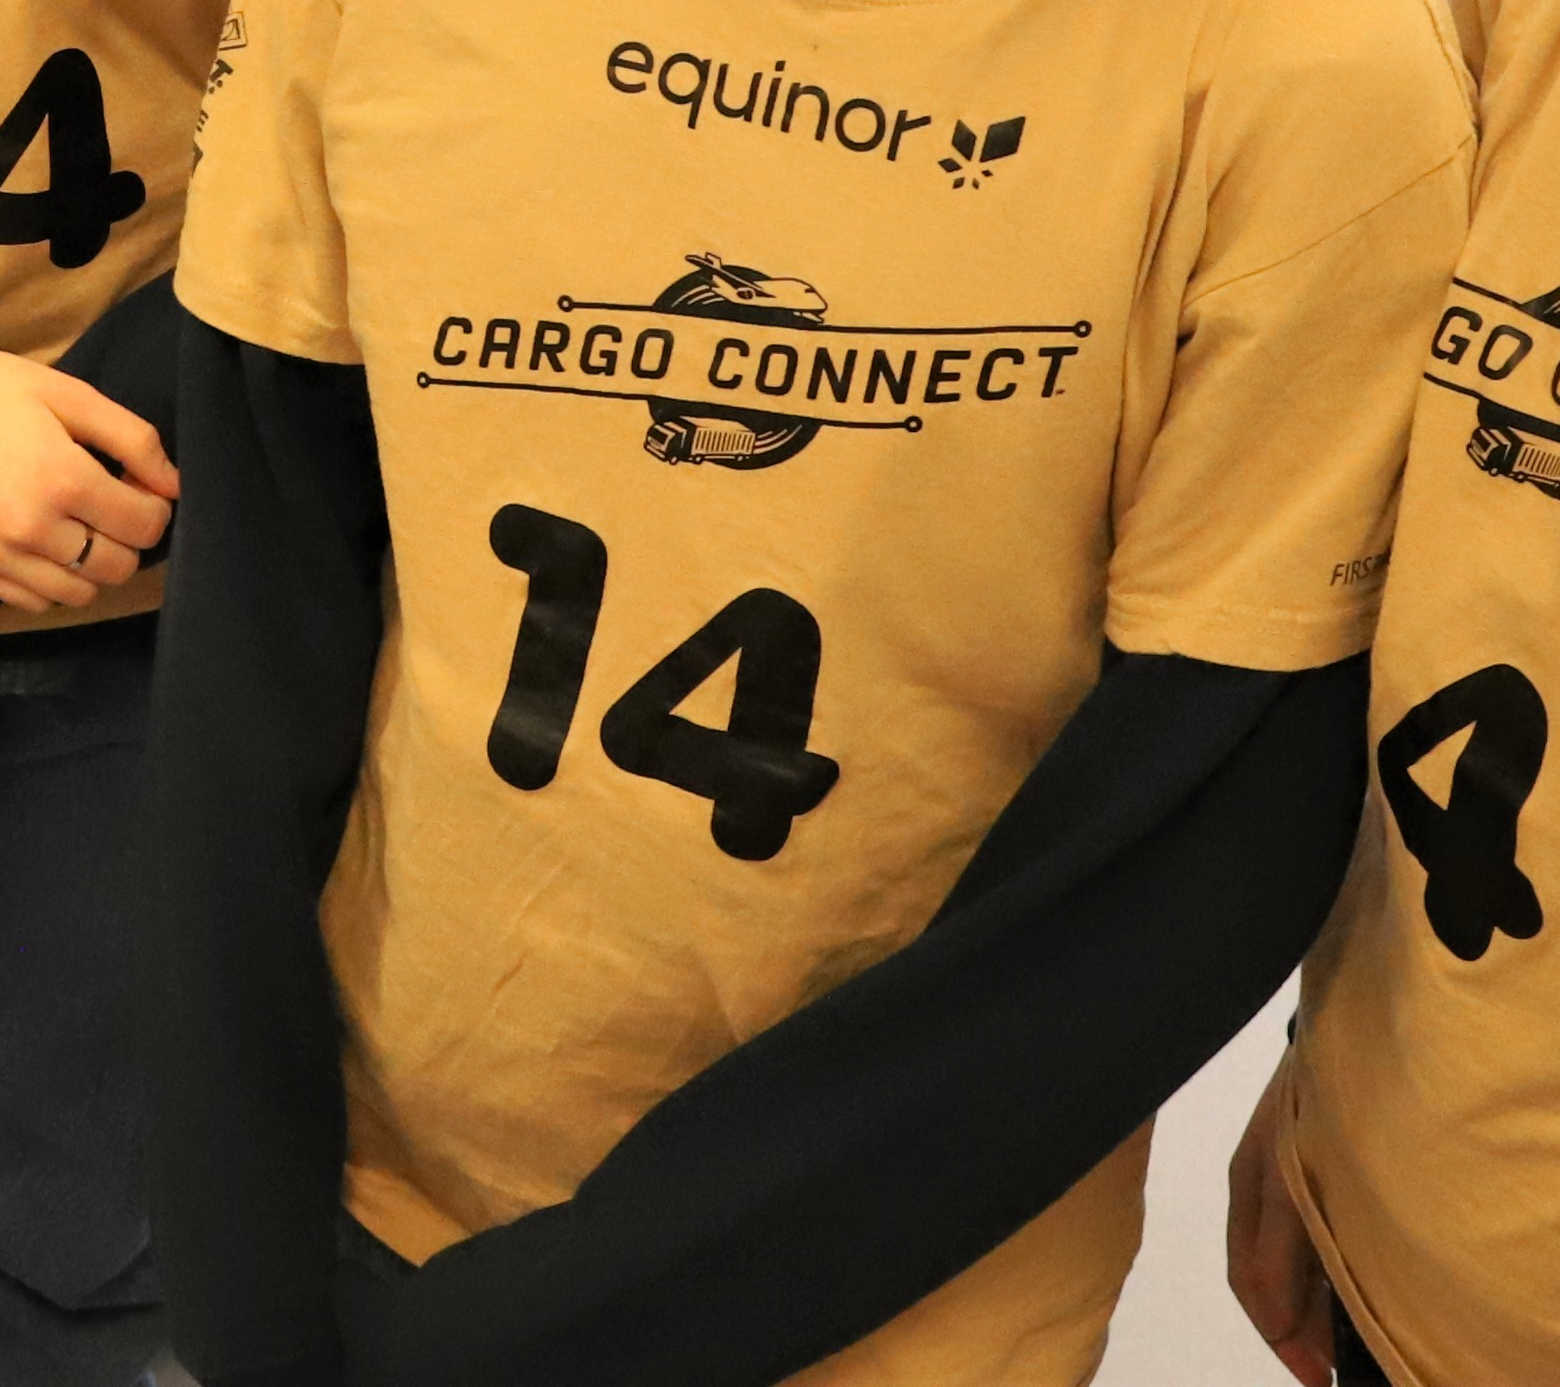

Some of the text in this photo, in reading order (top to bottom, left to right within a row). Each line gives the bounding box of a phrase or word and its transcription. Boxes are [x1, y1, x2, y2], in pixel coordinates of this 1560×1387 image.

[605, 40, 932, 162] equinor
[432, 315, 1079, 405] CARGO CONNECT
[1329, 556, 1375, 588] FIRS
[486, 502, 841, 863] 14
[1376, 662, 1549, 962] 4
